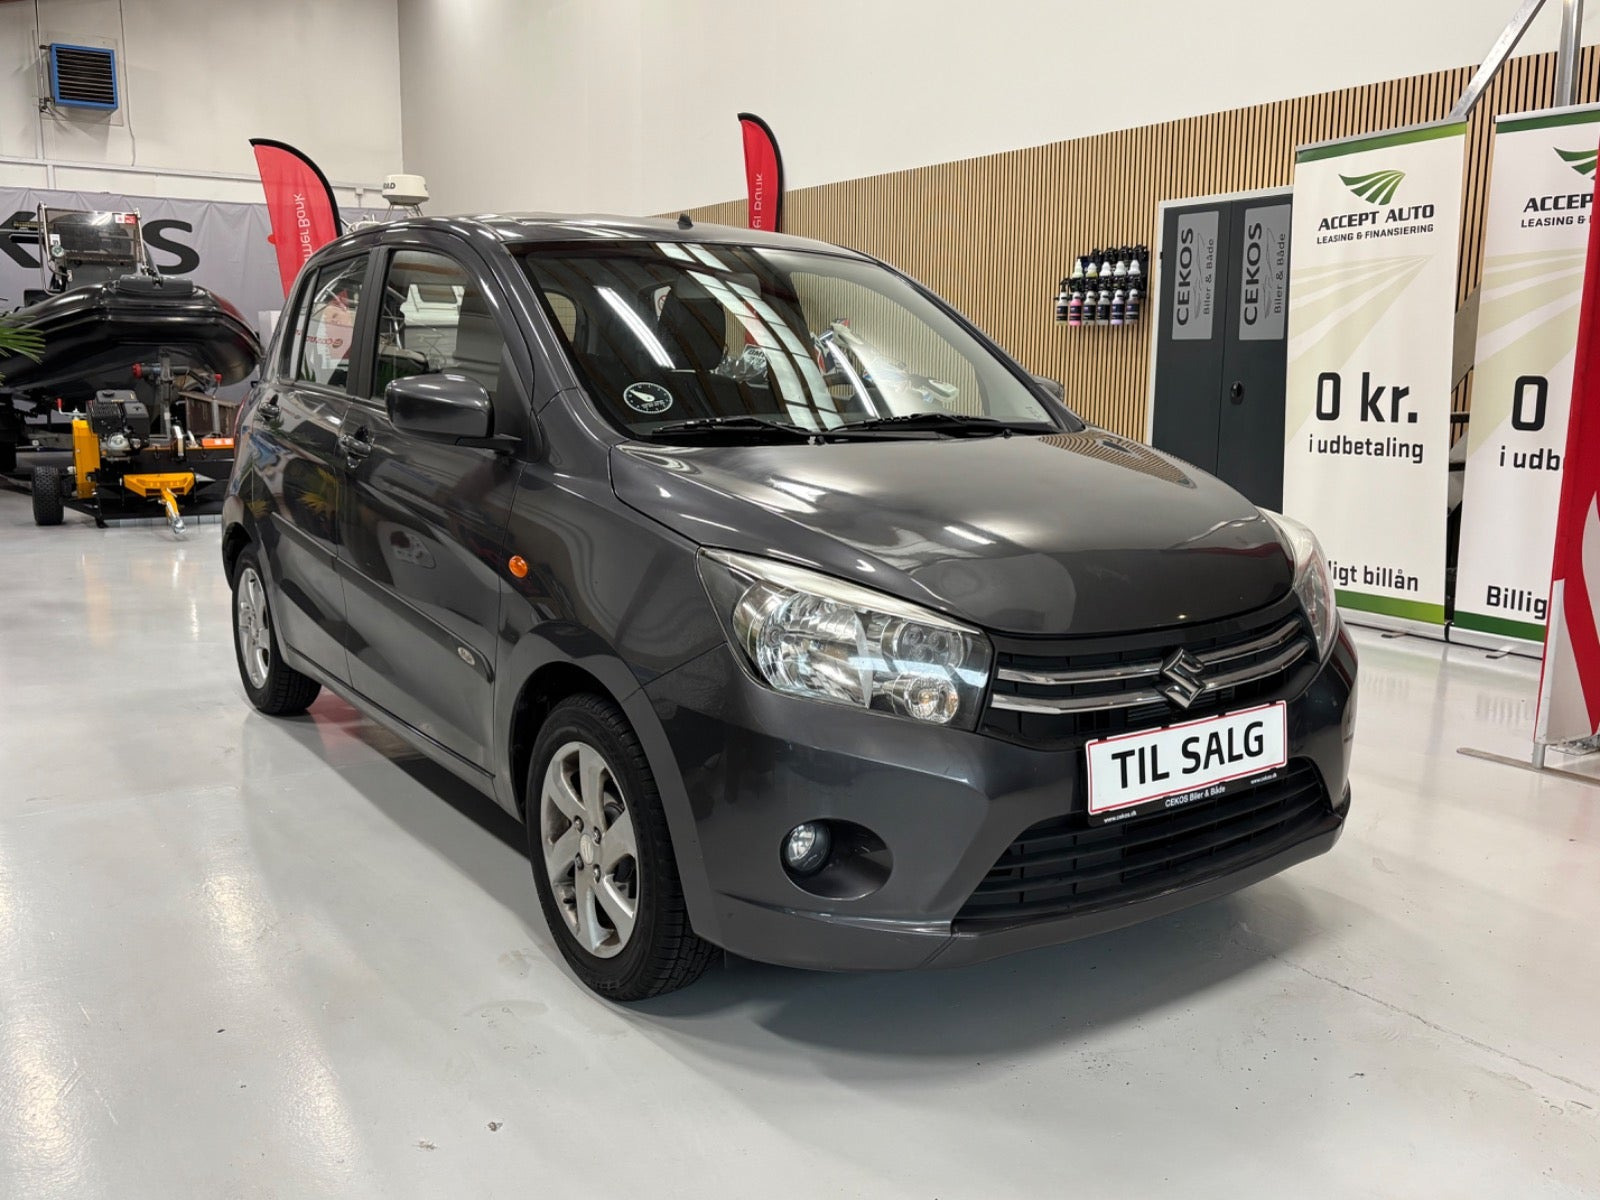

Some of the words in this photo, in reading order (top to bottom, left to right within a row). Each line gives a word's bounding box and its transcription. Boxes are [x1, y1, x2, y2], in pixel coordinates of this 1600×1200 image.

[1523, 193, 1594, 213] ACCEP
[1318, 210, 1380, 232] ACCEPT
[1384, 204, 1435, 223] AUTO
[1521, 216, 1574, 228] LEASING
[1577, 215, 1586, 224] &
[1317, 232, 1354, 245] LEASING
[1356, 232, 1364, 240] &
[1364, 223, 1434, 240] FINANSIERING
[1206, 238, 1214, 269] Både
[1277, 233, 1286, 266] Både
[1177, 227, 1194, 326] CEKOS
[1205, 274, 1212, 284] &
[1244, 222, 1262, 326] CEKOS
[1275, 270, 1284, 281] &
[1203, 287, 1211, 315] Biler
[1274, 286, 1283, 313] Biler
[1316, 372, 1341, 421] 0
[1360, 371, 1418, 423] kr.
[1511, 375, 1548, 432] 0
[1309, 433, 1313, 453] i
[1318, 435, 1424, 464] udbetaling
[1500, 445, 1506, 467] i
[1513, 448, 1560, 471] udb
[1363, 565, 1418, 591] billån
[1486, 585, 1547, 620] Billig
[1111, 744, 1170, 789] TIL
[1181, 721, 1264, 774] SALG
[1165, 794, 1188, 808] CEKOS
[1189, 791, 1203, 802] Biler
[1204, 789, 1209, 797] &
[1210, 785, 1226, 796] Både
